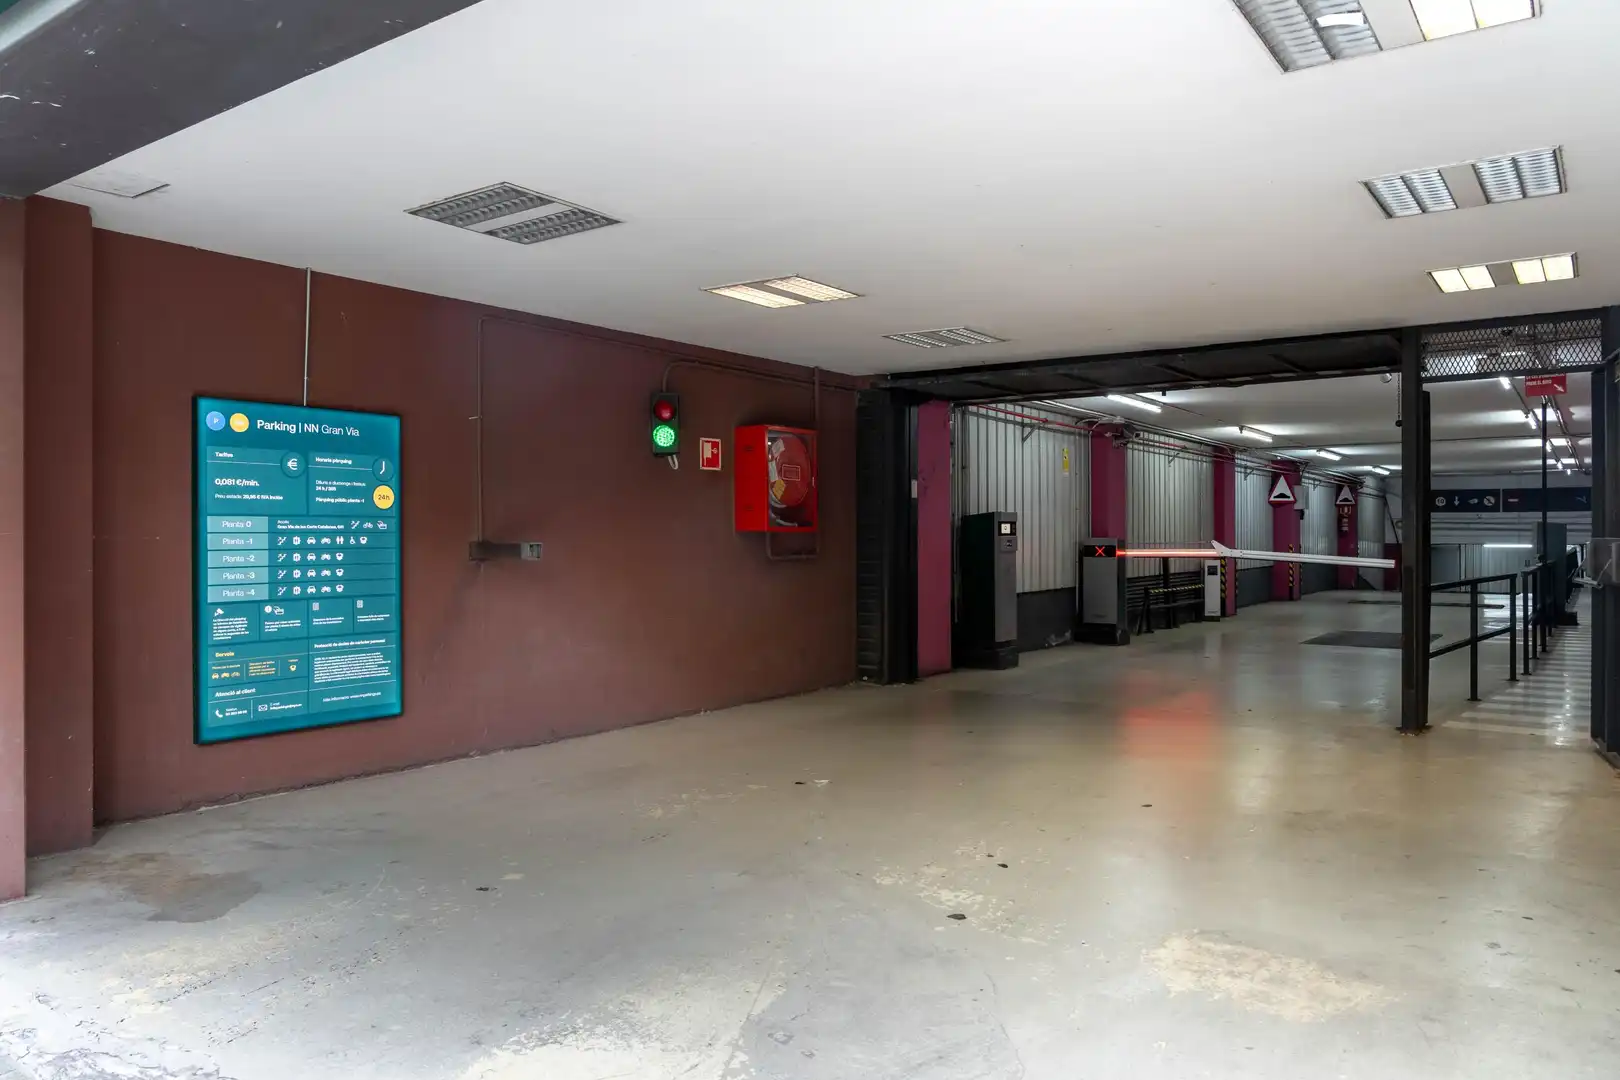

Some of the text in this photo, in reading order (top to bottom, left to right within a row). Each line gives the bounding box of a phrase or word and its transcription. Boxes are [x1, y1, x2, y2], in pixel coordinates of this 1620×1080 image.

[257, 420, 296, 434] Parking
[304, 424, 319, 433] NN
[322, 425, 344, 435] Gran
[346, 427, 360, 436] Via
[222, 555, 244, 563] Planta
